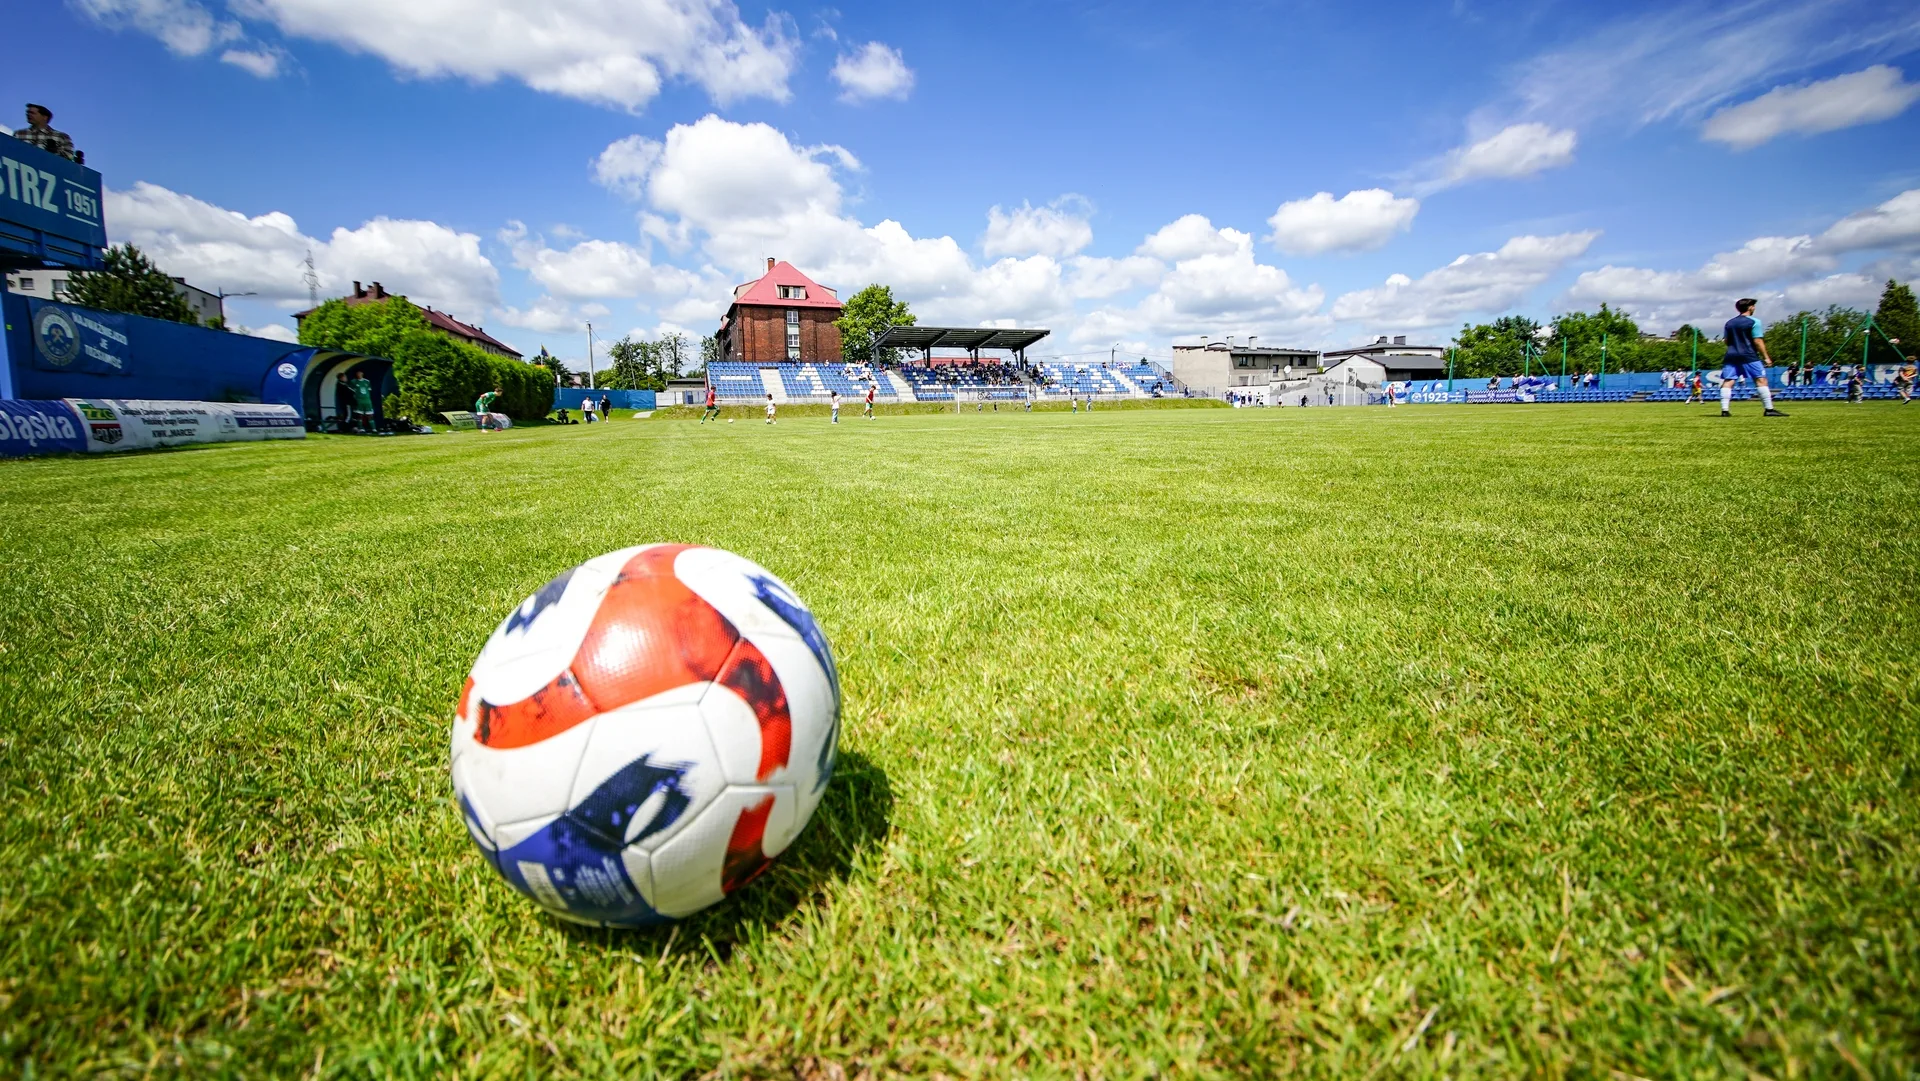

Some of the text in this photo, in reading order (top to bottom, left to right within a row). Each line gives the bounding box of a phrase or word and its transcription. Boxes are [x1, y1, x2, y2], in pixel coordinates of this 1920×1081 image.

[0, 156, 98, 218] TRZ 1951
[1423, 392, 1449, 402] 1923
